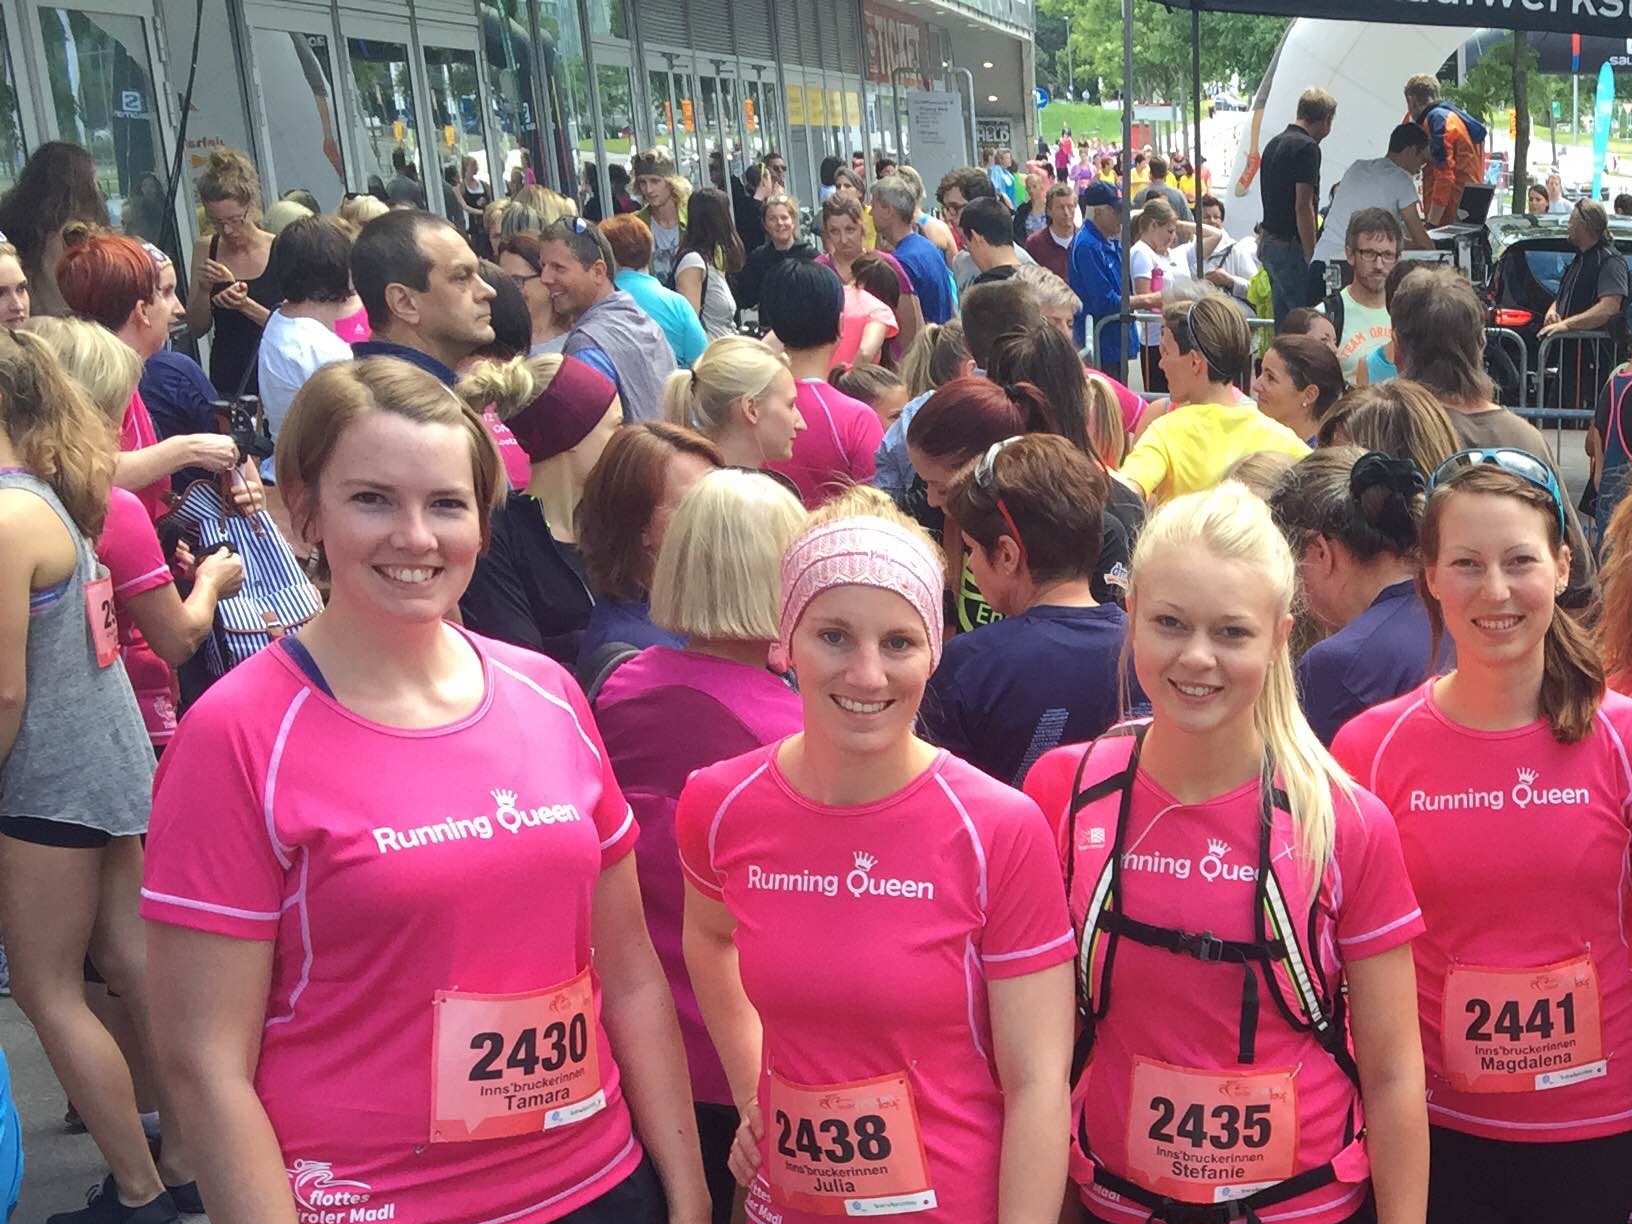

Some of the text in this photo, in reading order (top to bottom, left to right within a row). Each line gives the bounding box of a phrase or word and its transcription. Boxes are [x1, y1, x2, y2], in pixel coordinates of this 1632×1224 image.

[1410, 783, 1589, 811] Running Queen
[372, 803, 581, 854] Running Queen
[747, 865, 934, 900] Running Queen
[1465, 992, 1575, 1041] 2441
[468, 1012, 587, 1081] 2430
[1481, 1051, 1572, 1073] Magdalena
[504, 1087, 570, 1111] Tamara
[775, 1109, 891, 1164] 2438
[1148, 1096, 1271, 1150] 2435
[1172, 1161, 1245, 1180] Stefanie
[309, 1190, 370, 1206] flottes
[814, 1177, 855, 1193] Julia
[349, 1203, 395, 1224] Madl
